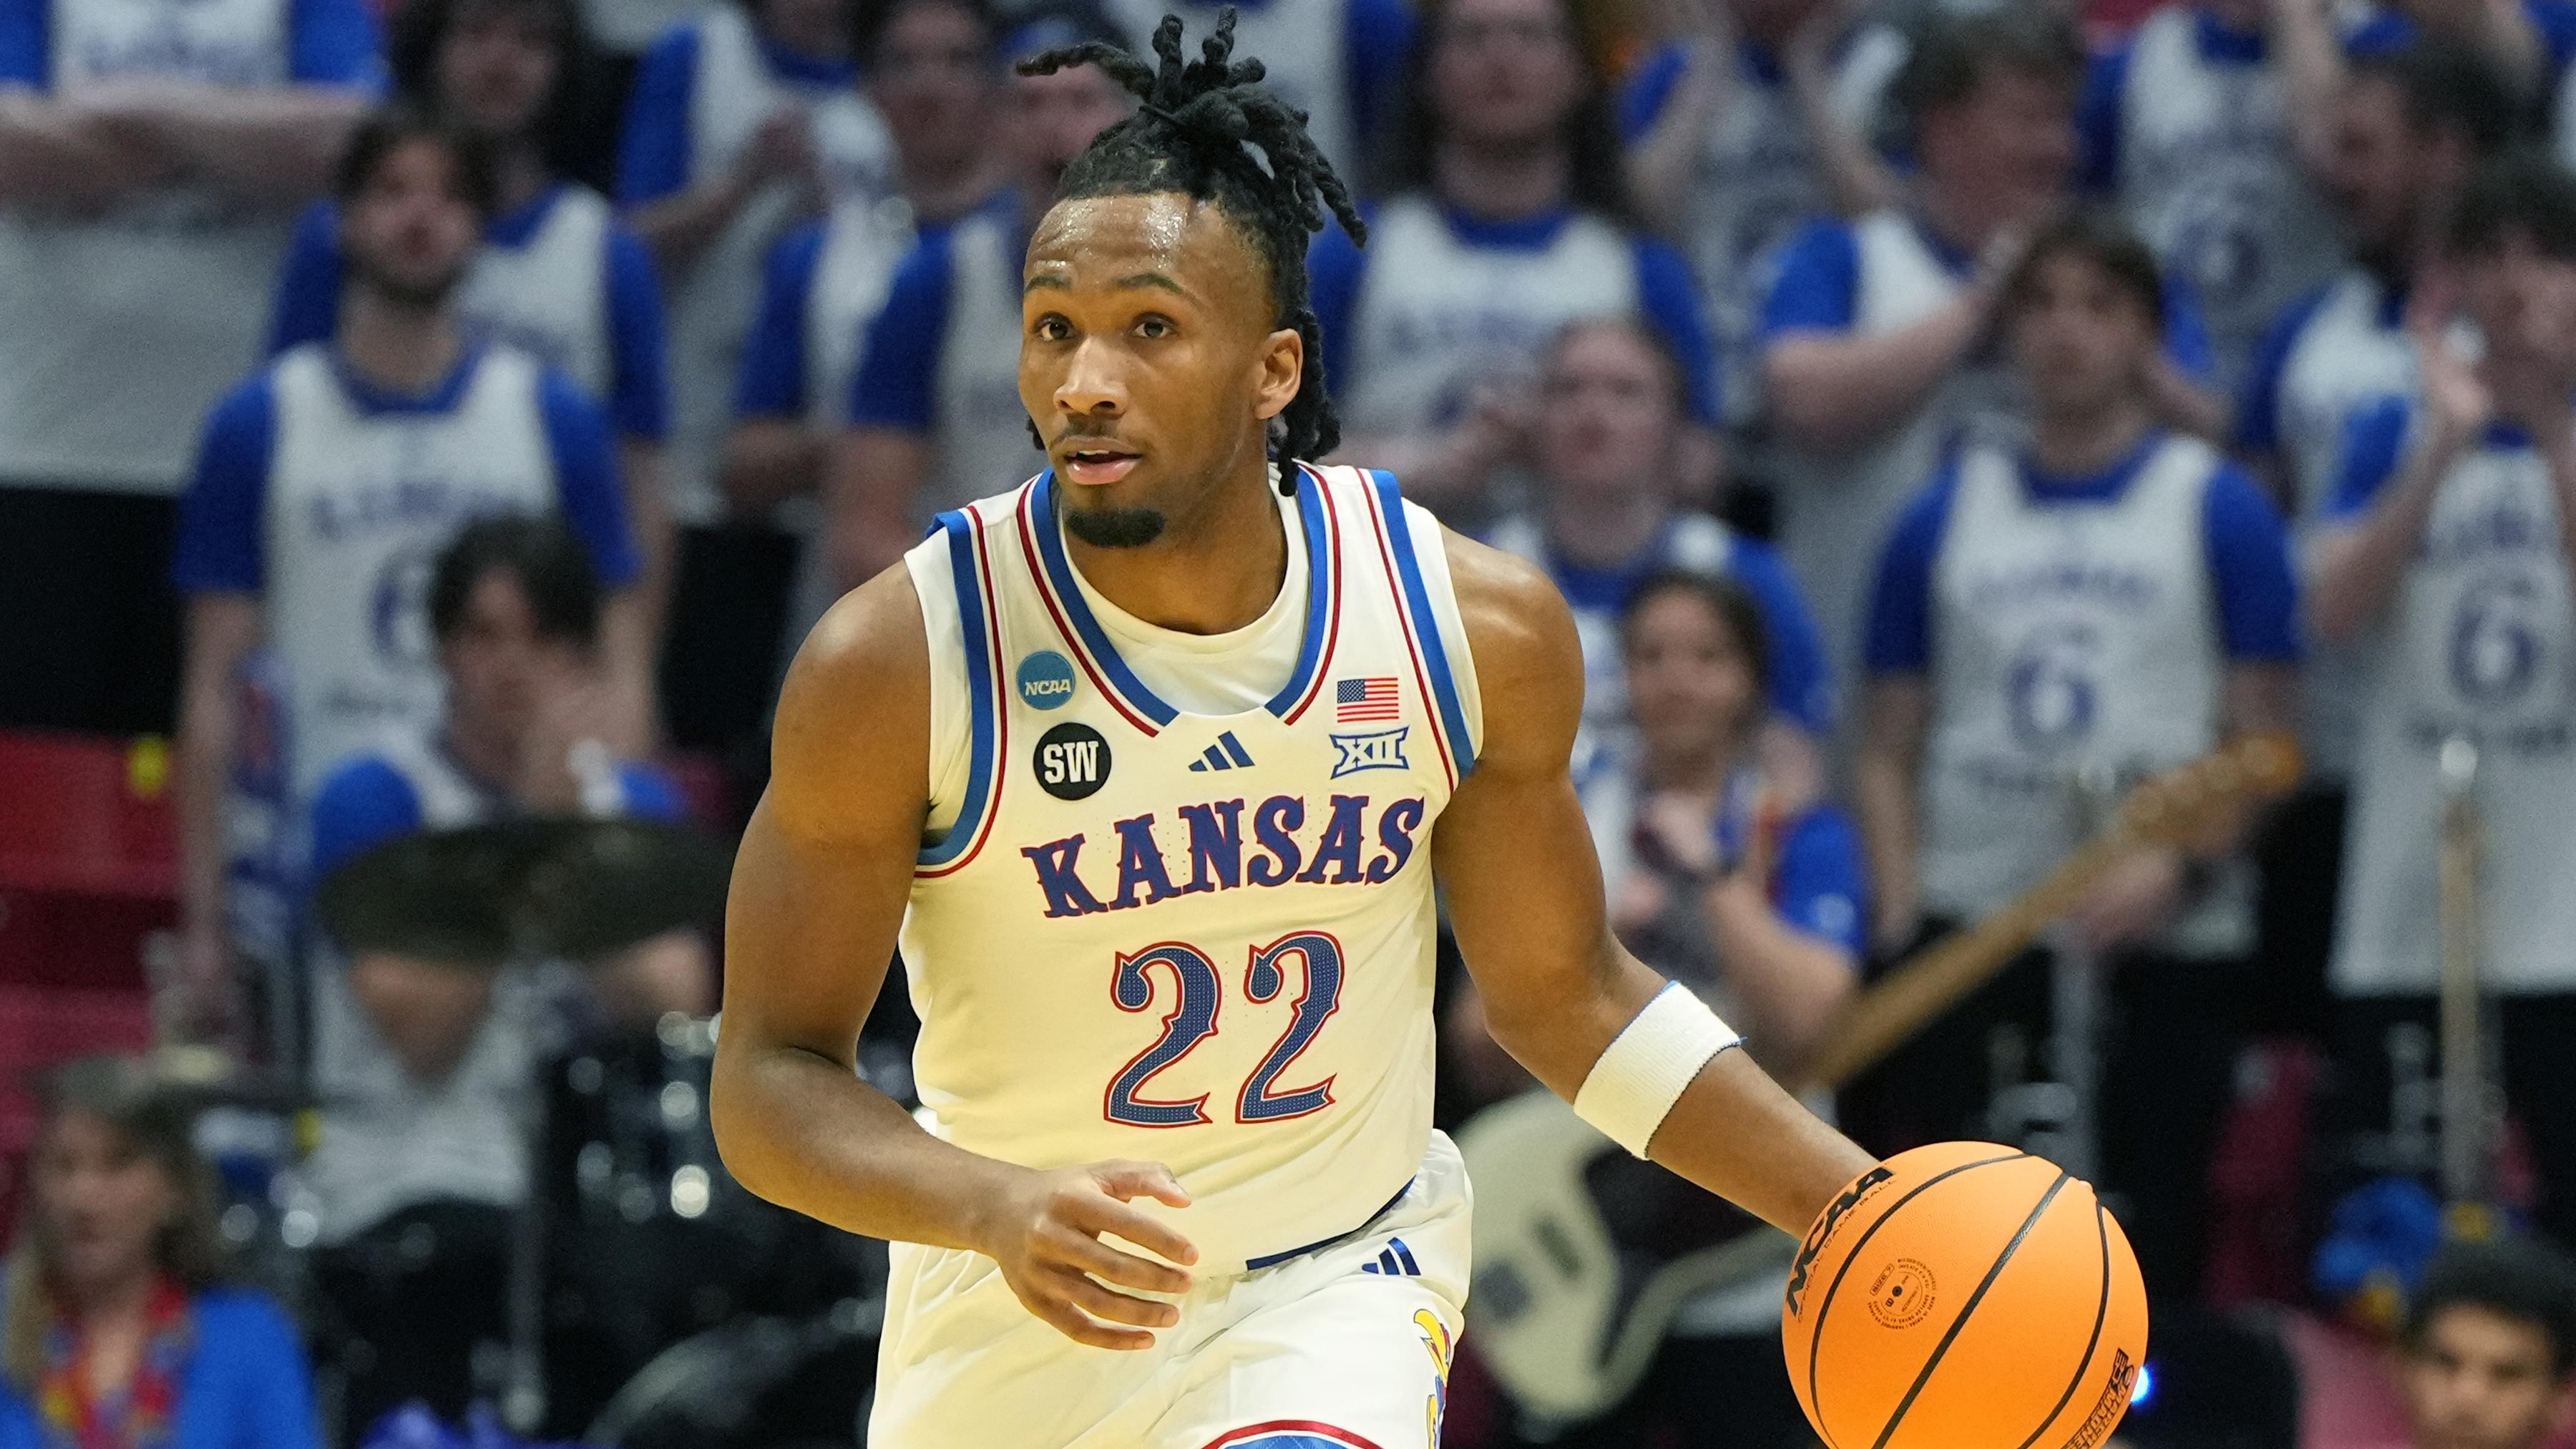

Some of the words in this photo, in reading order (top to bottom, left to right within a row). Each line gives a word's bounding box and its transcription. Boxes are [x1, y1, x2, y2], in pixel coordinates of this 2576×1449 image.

[2449, 567, 2539, 706] 6
[1025, 678, 1072, 696] NCAA
[2004, 618, 2099, 756] 6
[1043, 741, 1099, 784] SW
[1329, 725, 1410, 779] XII
[1021, 794, 1425, 918] KANSAS
[1103, 930, 1345, 1129] 22
[1786, 1167, 1893, 1317] NCAA
[1825, 1209, 1856, 1249] GAME
[1859, 1180, 1896, 1205] BALL
[2065, 1384, 2118, 1449] MADNE
